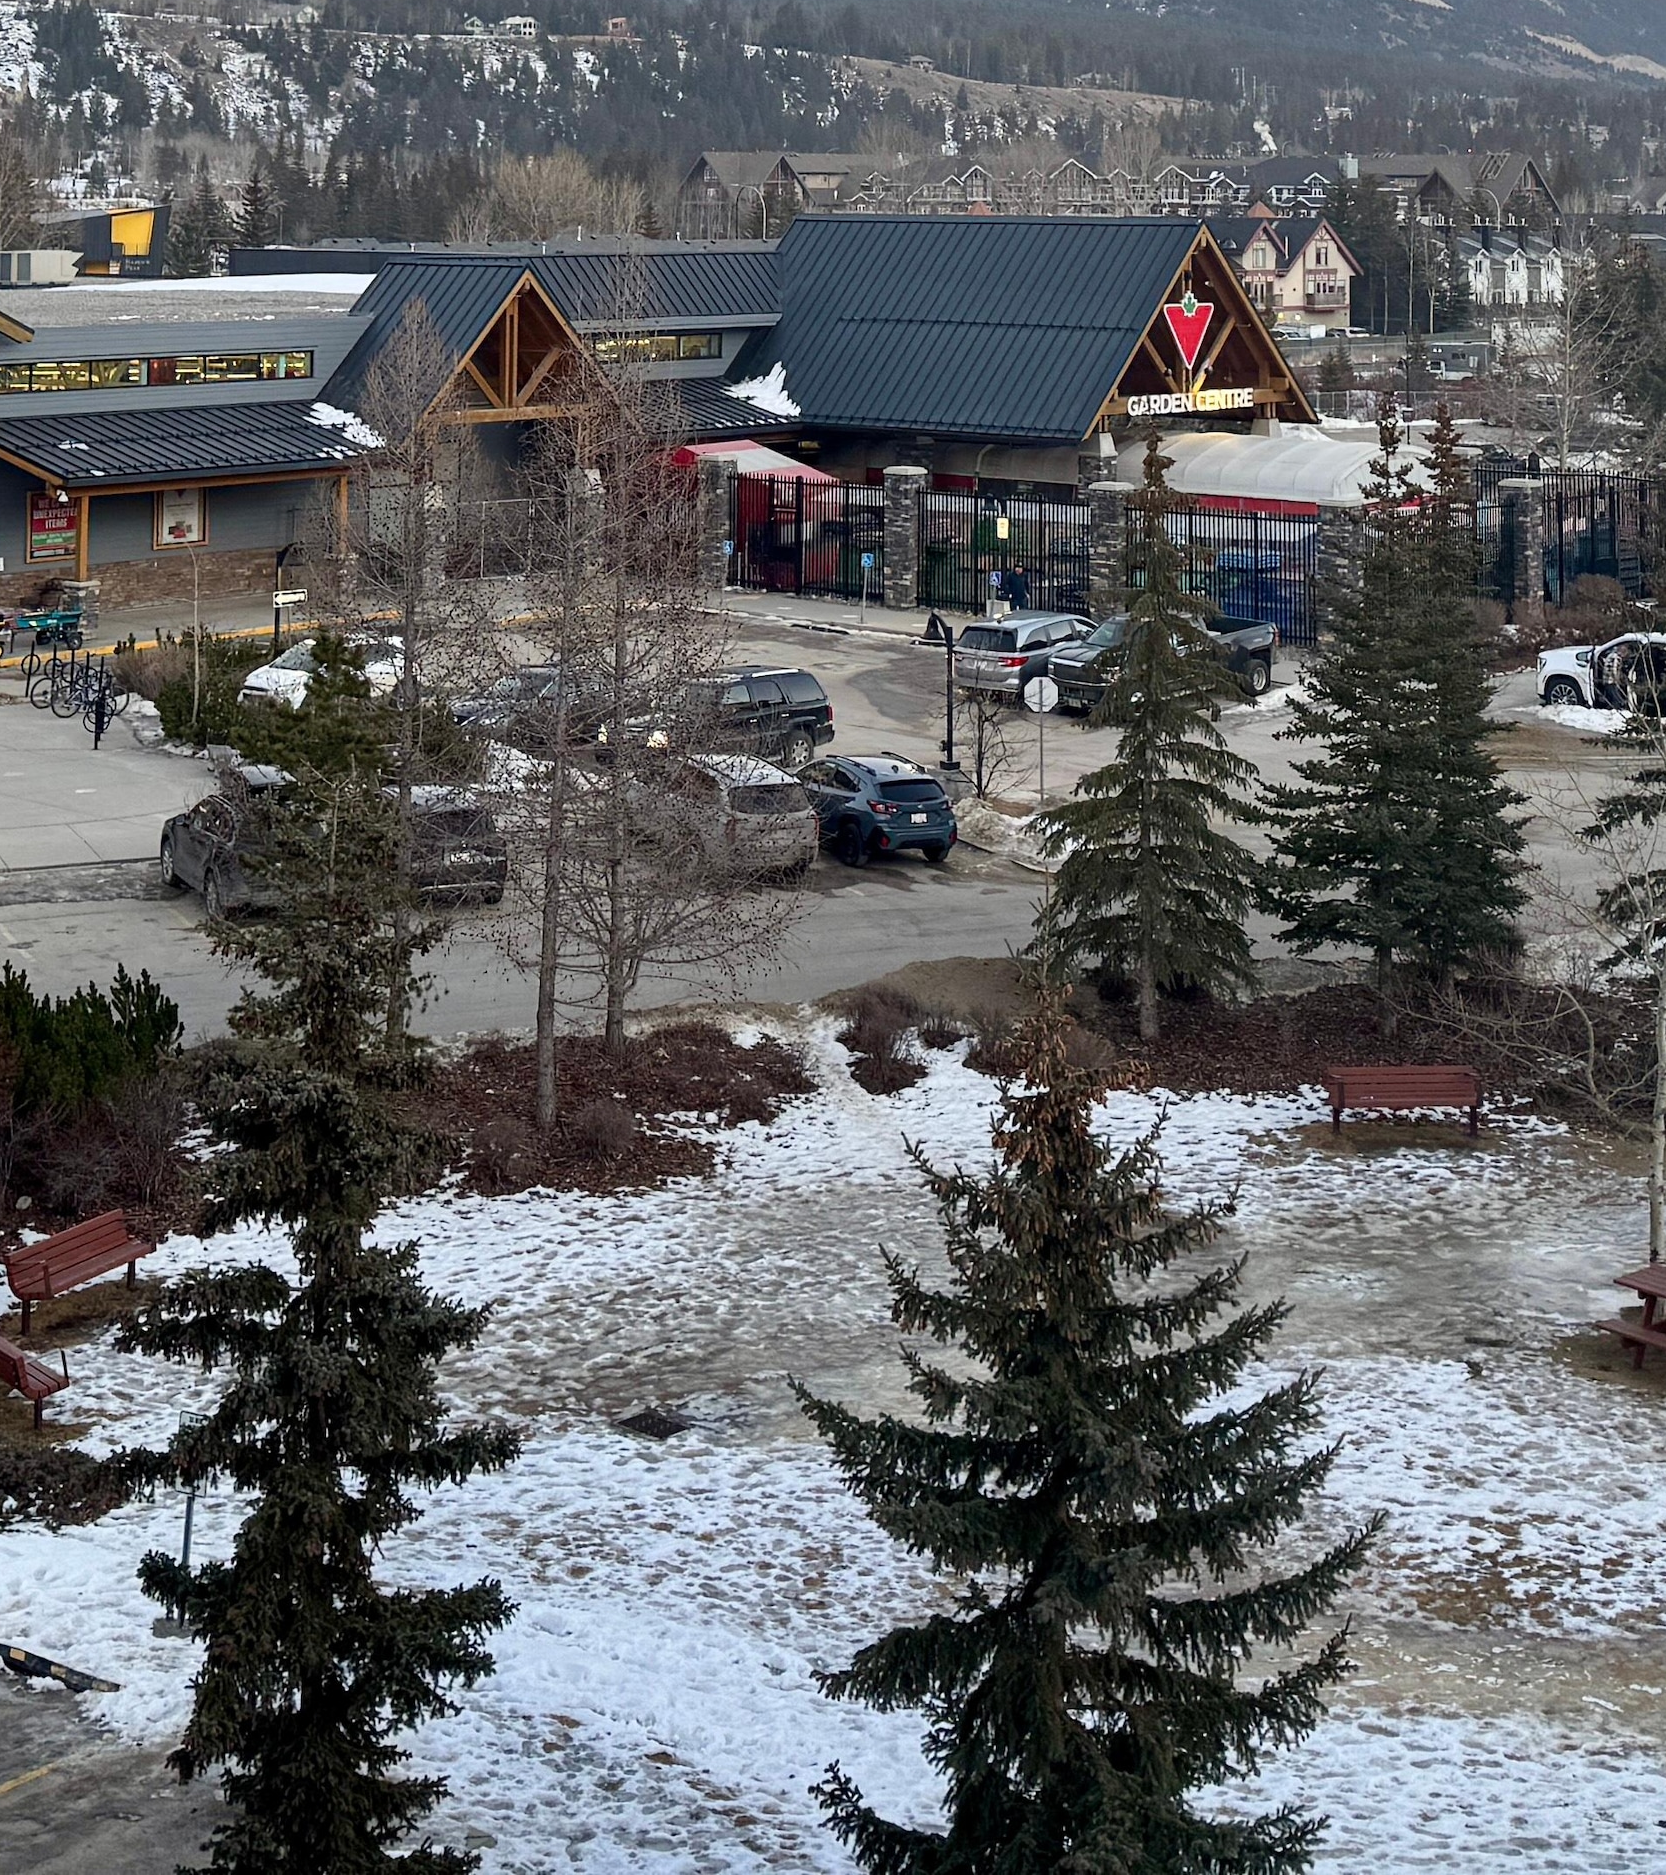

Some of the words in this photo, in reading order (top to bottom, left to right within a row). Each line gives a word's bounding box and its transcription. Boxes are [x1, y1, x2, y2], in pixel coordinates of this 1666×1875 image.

[1127, 393, 1193, 416] GARDEN
[1196, 387, 1254, 412] CENTRE
[33, 507, 77, 520] UNEXPECTE
